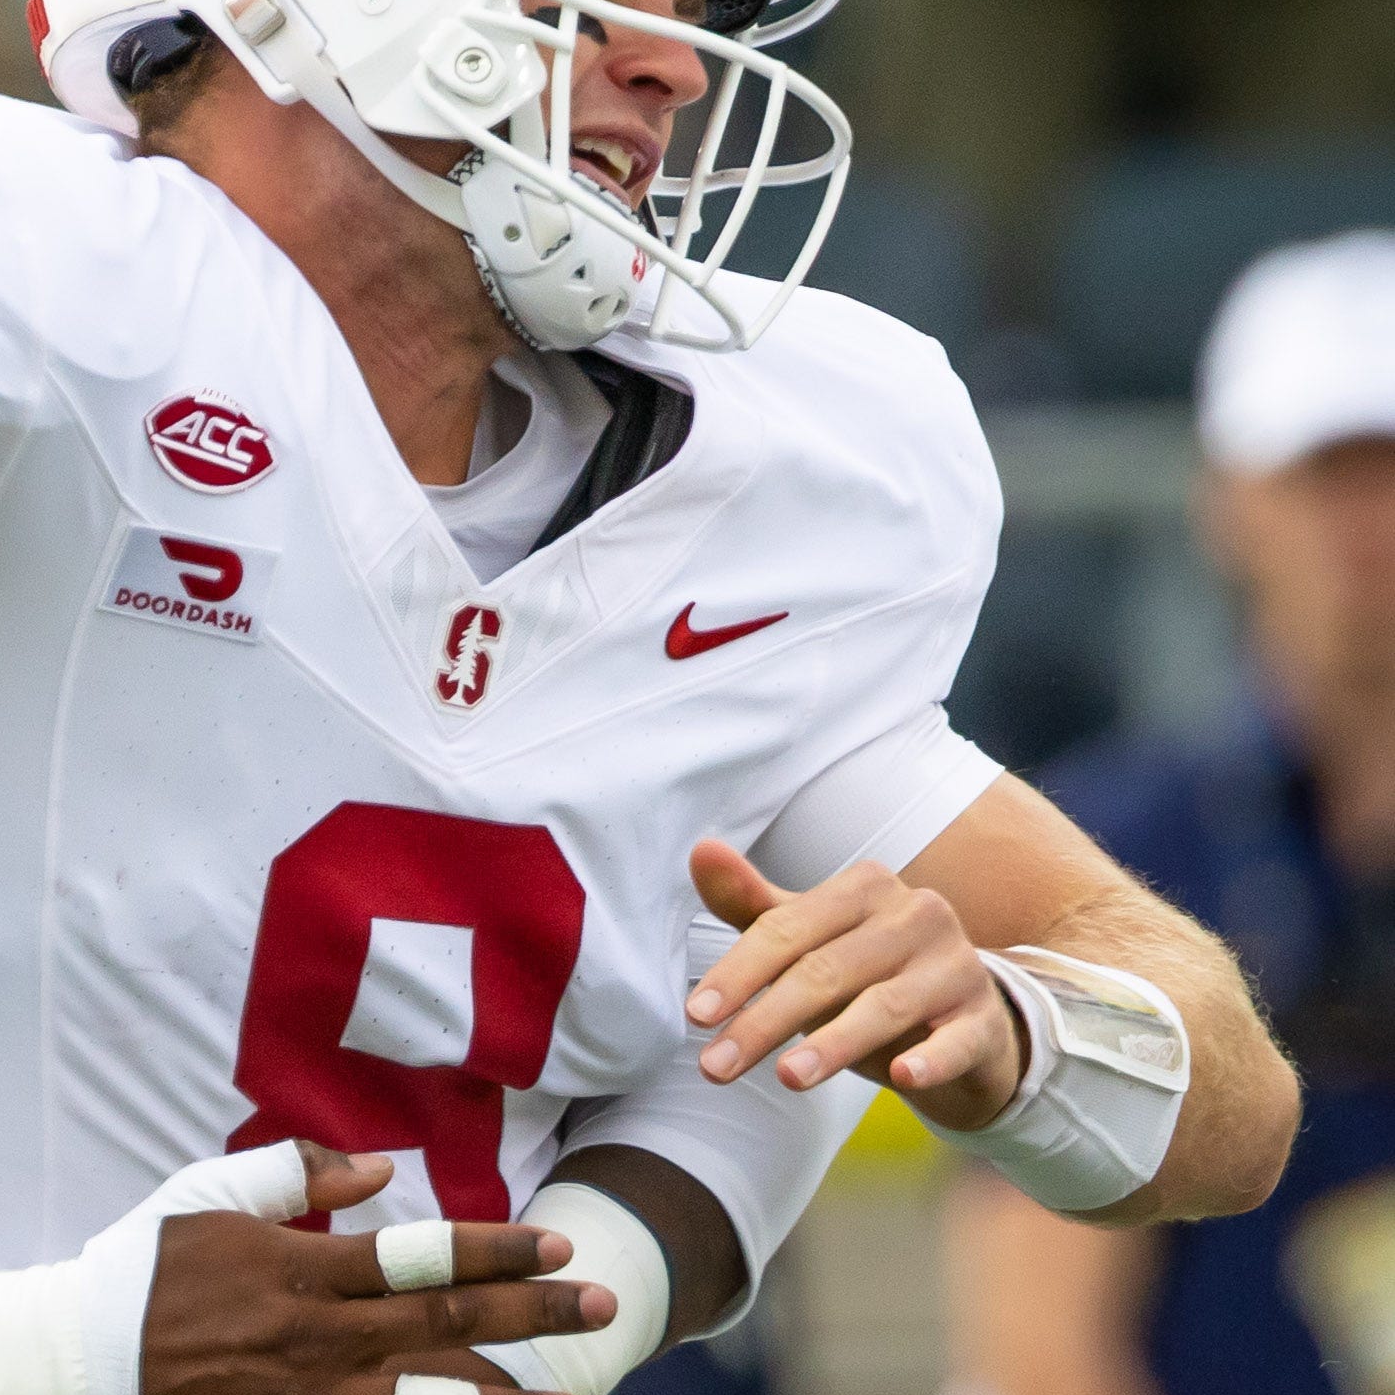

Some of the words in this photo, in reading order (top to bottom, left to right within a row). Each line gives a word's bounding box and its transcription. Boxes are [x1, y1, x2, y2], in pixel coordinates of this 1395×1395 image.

[160, 410, 265, 464] ACC
[115, 587, 253, 634] DOORDASH
[434, 600, 503, 711] S
[225, 800, 586, 1234] 8
